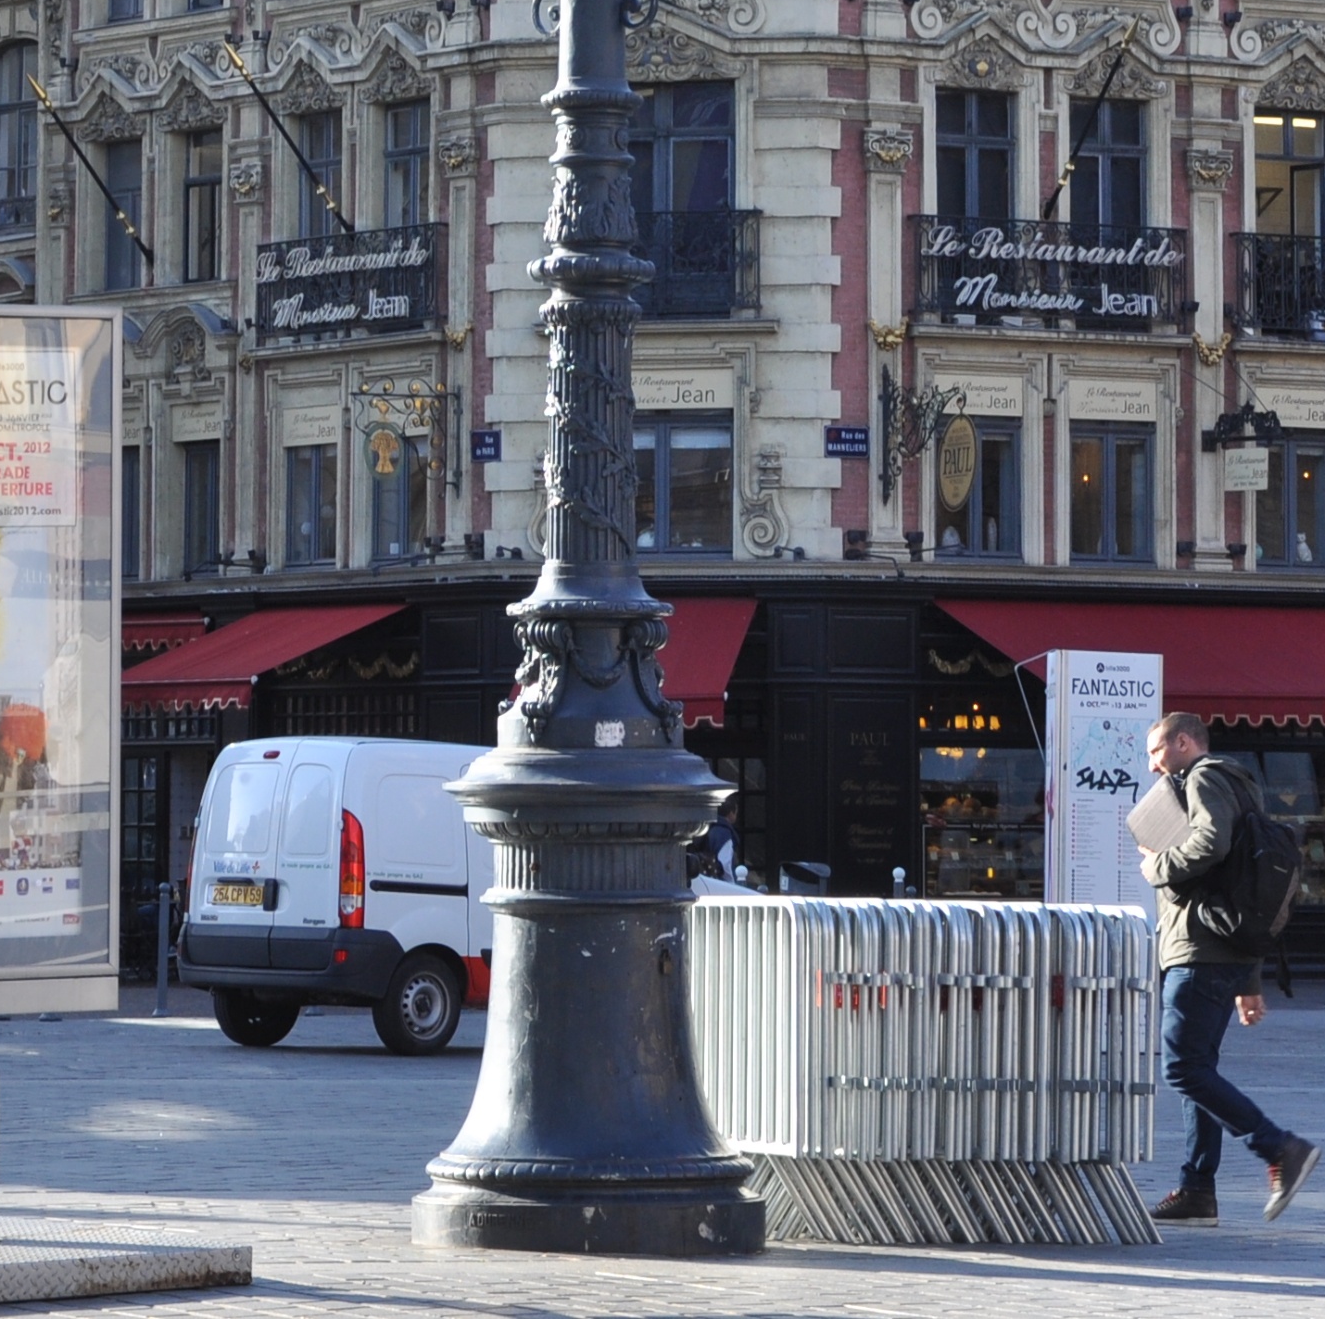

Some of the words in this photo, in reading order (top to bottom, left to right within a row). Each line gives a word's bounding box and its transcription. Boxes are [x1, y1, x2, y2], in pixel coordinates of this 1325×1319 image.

[921, 225, 965, 258] Le
[969, 227, 1143, 266] Restaurant
[1144, 237, 1184, 267] de
[253, 251, 281, 283] Le
[283, 238, 403, 280] Restaurant
[400, 236, 428, 267] de
[953, 272, 1084, 311] Monsieur
[1092, 283, 1159, 318] Jean
[273, 292, 360, 329] Monsieur
[361, 288, 409, 321] Jean
[640, 376, 694, 387] Restaurant
[671, 385, 716, 405] Jean
[1096, 387, 1142, 398] Restaurant
[986, 394, 1017, 410] Jean
[1280, 394, 1325, 406] Restaurant
[1121, 400, 1150, 415] Jean
[123, 426, 140, 440] Jean
[202, 420, 222, 434] Jean
[316, 424, 336, 438] Jean
[485, 435, 494, 444] Rue
[841, 431, 852, 440] Rue
[854, 431, 865, 440] des
[23, 442, 51, 453] 2012
[828, 443, 867, 453] MANNELIERS
[943, 446, 973, 475] PAUL
[1072, 678, 1156, 698] FANTASTIC
[850, 732, 890, 746] PAUL
[213, 861, 226, 874] Ville
[227, 861, 235, 874] de
[236, 861, 251, 875] Lille
[387, 872, 403, 880] propre
[213, 887, 230, 903] 254
[230, 887, 249, 903] CPV
[249, 887, 262, 903] 59
